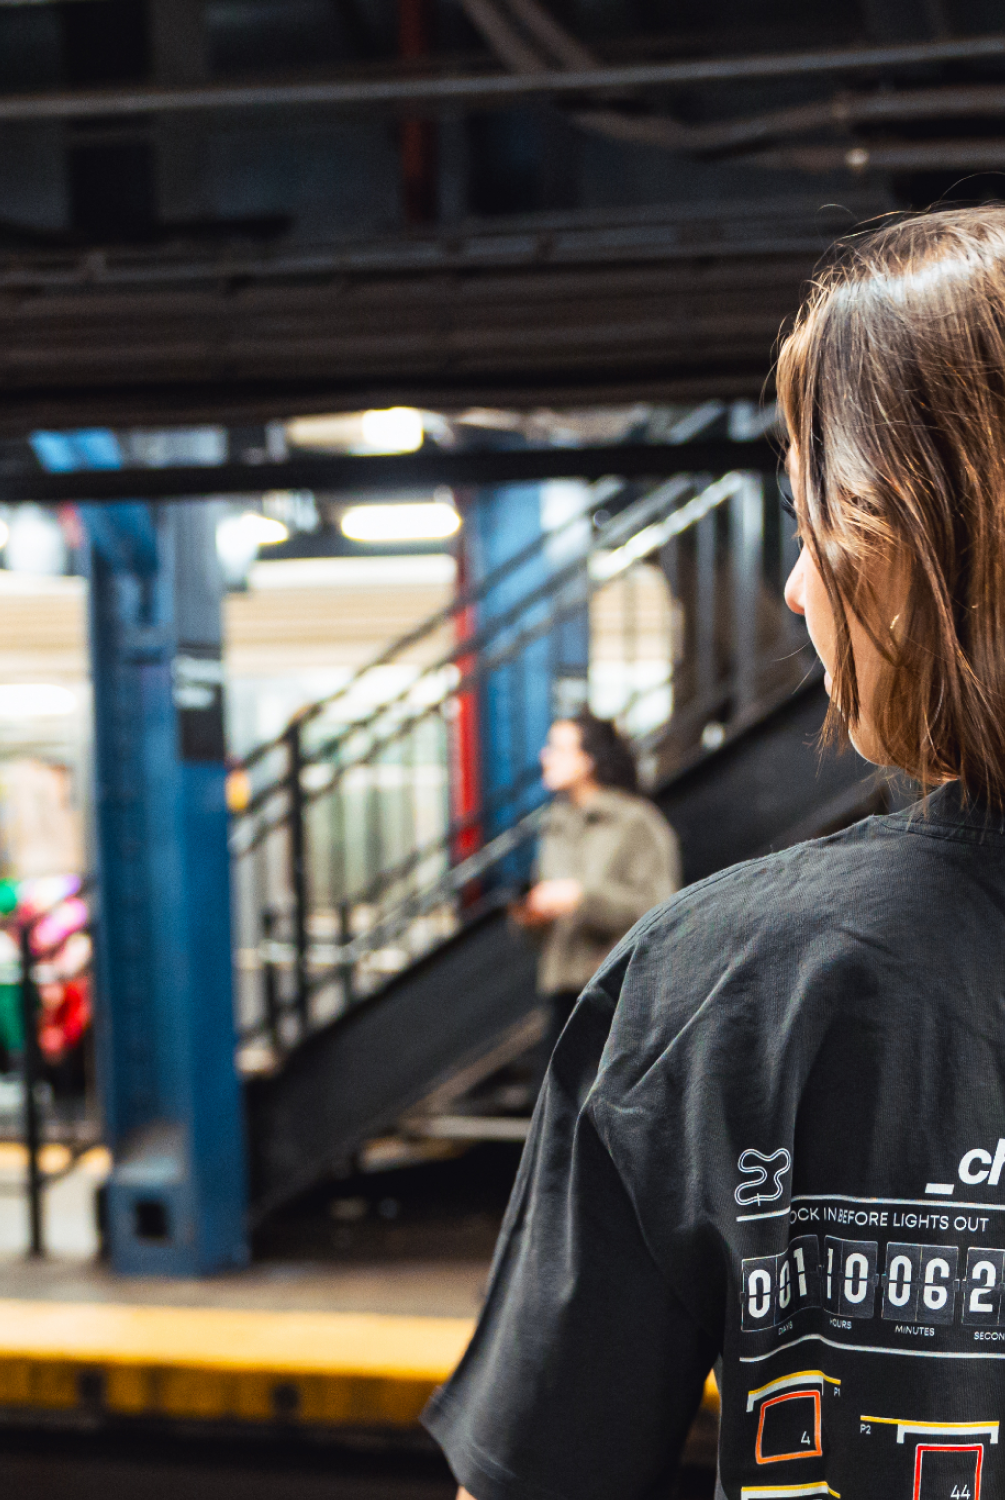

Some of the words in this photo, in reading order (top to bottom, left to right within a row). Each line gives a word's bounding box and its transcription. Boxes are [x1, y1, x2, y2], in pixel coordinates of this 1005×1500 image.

[790, 1207, 820, 1224] OCK
[823, 1207, 837, 1221] IN
[837, 1209, 888, 1226] BEFORE
[893, 1213, 949, 1230] LIGHTS
[954, 1217, 989, 1232] OUT
[826, 1248, 869, 1303] 10
[888, 1255, 950, 1310] 06
[894, 1325, 935, 1337] MINUTES
[860, 1424, 871, 1435] P2
[800, 1431, 811, 1445] 4
[950, 1484, 971, 1500] 44
